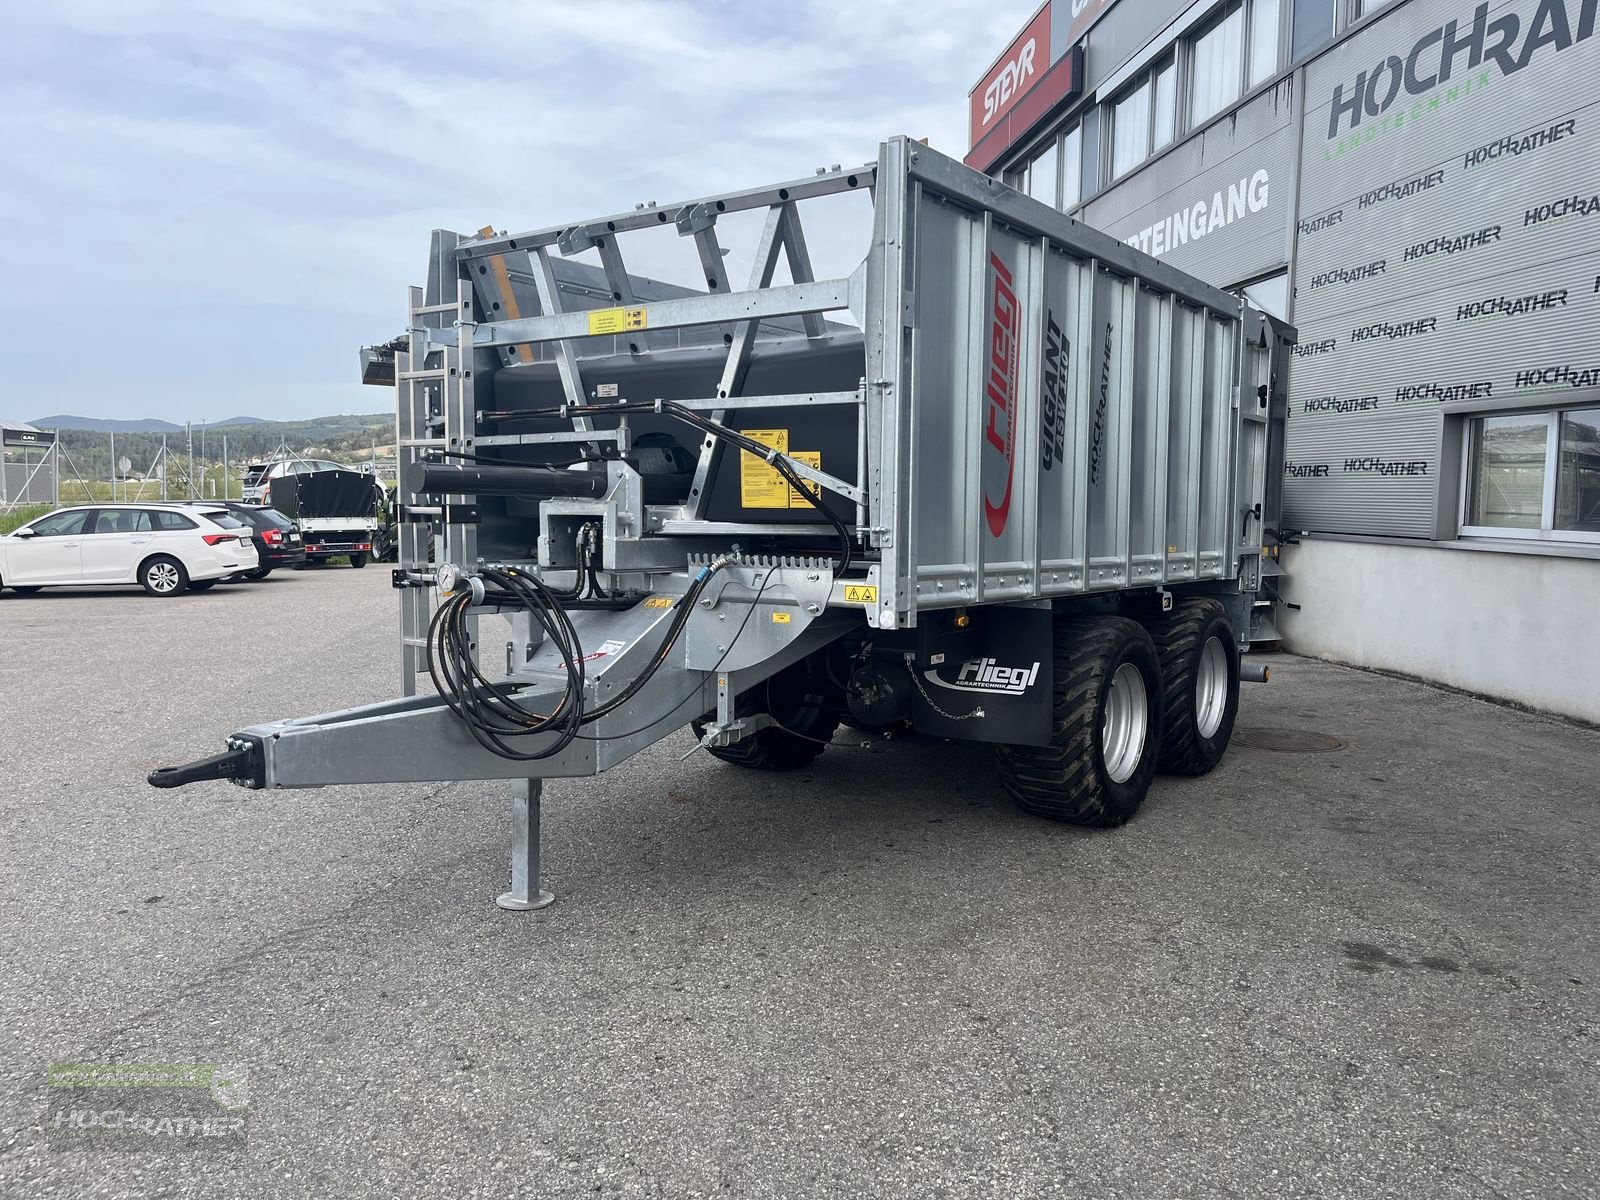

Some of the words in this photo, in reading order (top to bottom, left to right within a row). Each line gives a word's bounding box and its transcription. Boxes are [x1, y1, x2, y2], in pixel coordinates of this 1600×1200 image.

[982, 37, 1036, 127] STEYR
[1463, 119, 1576, 169] HOCHRATHER
[1359, 170, 1445, 210] HOCHRATHER
[1403, 225, 1502, 262] HOCHRATHER
[1310, 259, 1387, 290] HOCHRATHER
[1456, 289, 1569, 321] HOCHRATHER
[1351, 317, 1438, 343] HOCHRATHER
[1042, 307, 1062, 472] GIGANT
[1059, 349, 1070, 397] 110
[1395, 381, 1493, 402] HOCHRATHER
[1006, 342, 1016, 462] AGRARTECHNIK
[1090, 321, 1114, 485] HOCHRATHER
[1304, 396, 1379, 413] HOCHRATHER
[1055, 397, 1066, 449] ASW
[1343, 457, 1428, 476] HOCHRATHER
[955, 680, 1007, 689] AGRARTECHNIK
[958, 657, 1040, 691] Fliegl
